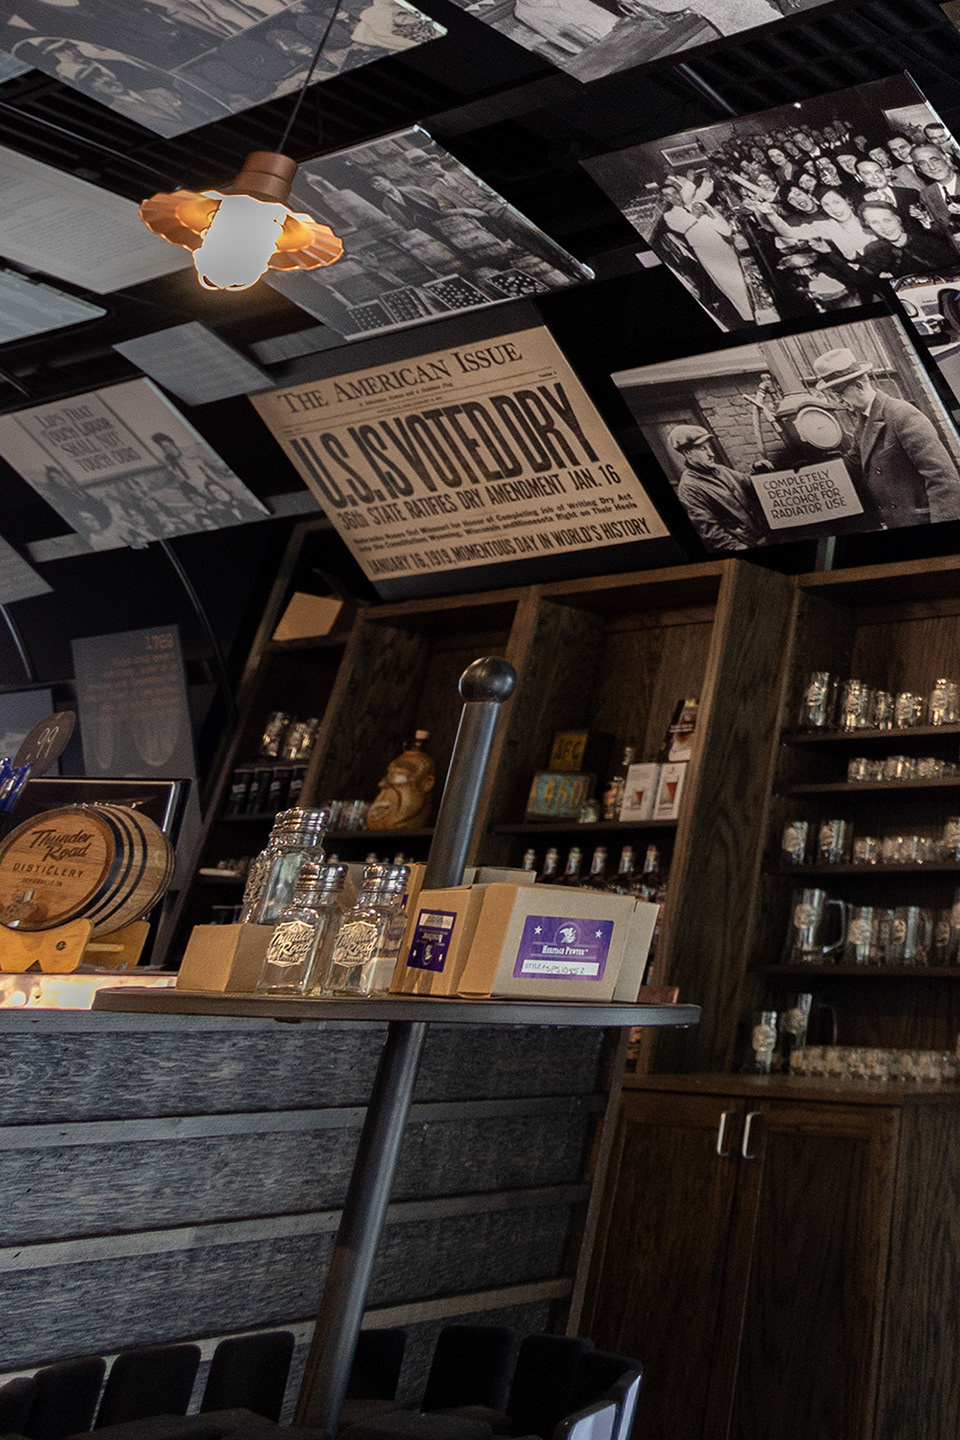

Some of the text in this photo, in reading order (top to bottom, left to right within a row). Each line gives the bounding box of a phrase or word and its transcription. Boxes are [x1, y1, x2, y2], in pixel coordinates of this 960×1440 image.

[277, 390, 329, 413] THE
[333, 360, 453, 403] AMERICAN
[450, 342, 523, 374] ISSUE
[378, 382, 601, 493] VOTED DRY
[763, 469, 830, 490] COMPLETELY
[767, 480, 835, 500] DENATURED
[366, 464, 621, 526] STATE RATIFIES DRY AMENDMENT JAN. 16
[773, 487, 841, 508] ALCOHOL FOR
[771, 496, 847, 519] RADIATOR USE
[450, 538, 517, 562] MOMENTOUS
[514, 534, 539, 553] DAY
[536, 531, 554, 550] IN
[551, 523, 603, 547] WORLD'S
[601, 517, 652, 540] HISTORY
[29, 829, 95, 848] Thunder
[42, 842, 92, 861] Road
